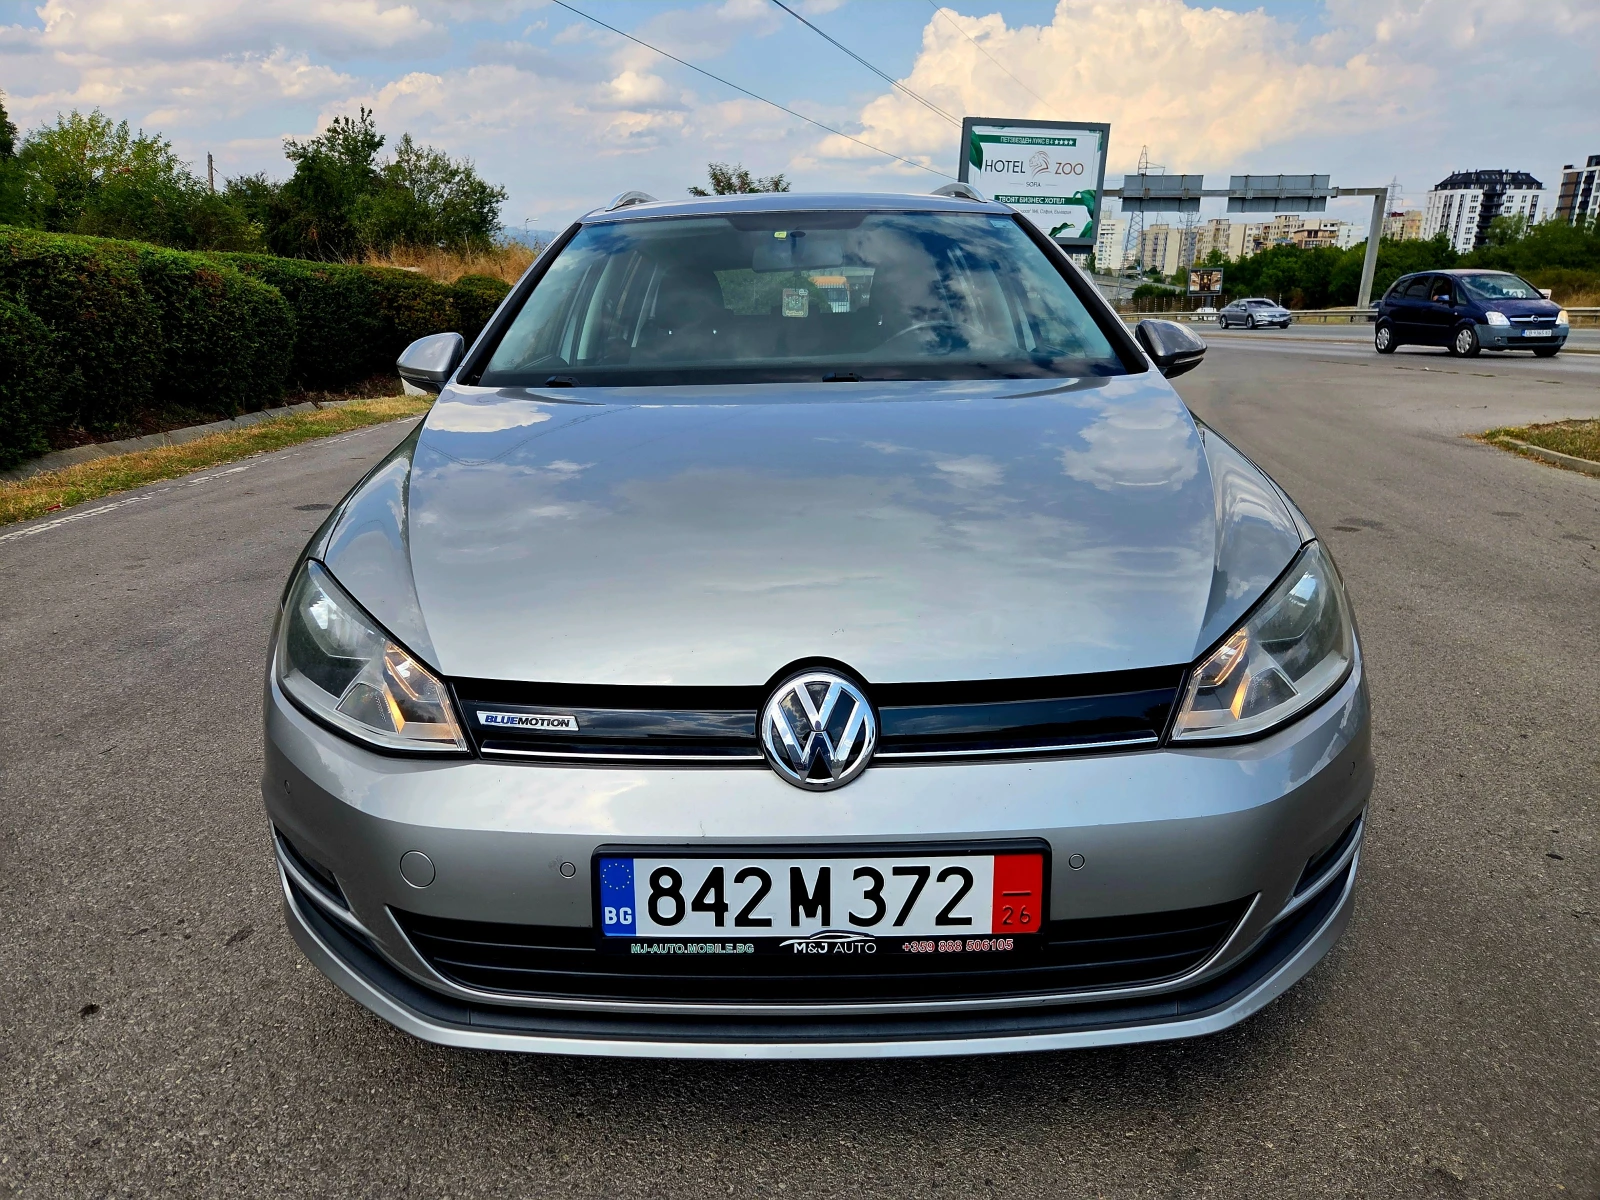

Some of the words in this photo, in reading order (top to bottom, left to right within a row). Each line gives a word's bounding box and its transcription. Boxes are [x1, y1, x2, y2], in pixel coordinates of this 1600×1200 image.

[985, 159, 1026, 174] HOTEL
[1054, 162, 1084, 175] ZOO
[485, 715, 570, 728] BLUEMOTION
[647, 866, 773, 928] 842
[789, 866, 831, 928] M
[848, 865, 974, 928] 372
[604, 906, 633, 925] BG
[1001, 904, 1031, 926] 26
[631, 943, 755, 954] MJ-AUTO.MOBILE.BG
[793, 942, 828, 954] M&J
[833, 942, 877, 954] AUTO
[902, 941, 936, 953] +359
[938, 940, 963, 953] 888
[965, 938, 1014, 952] 506105
